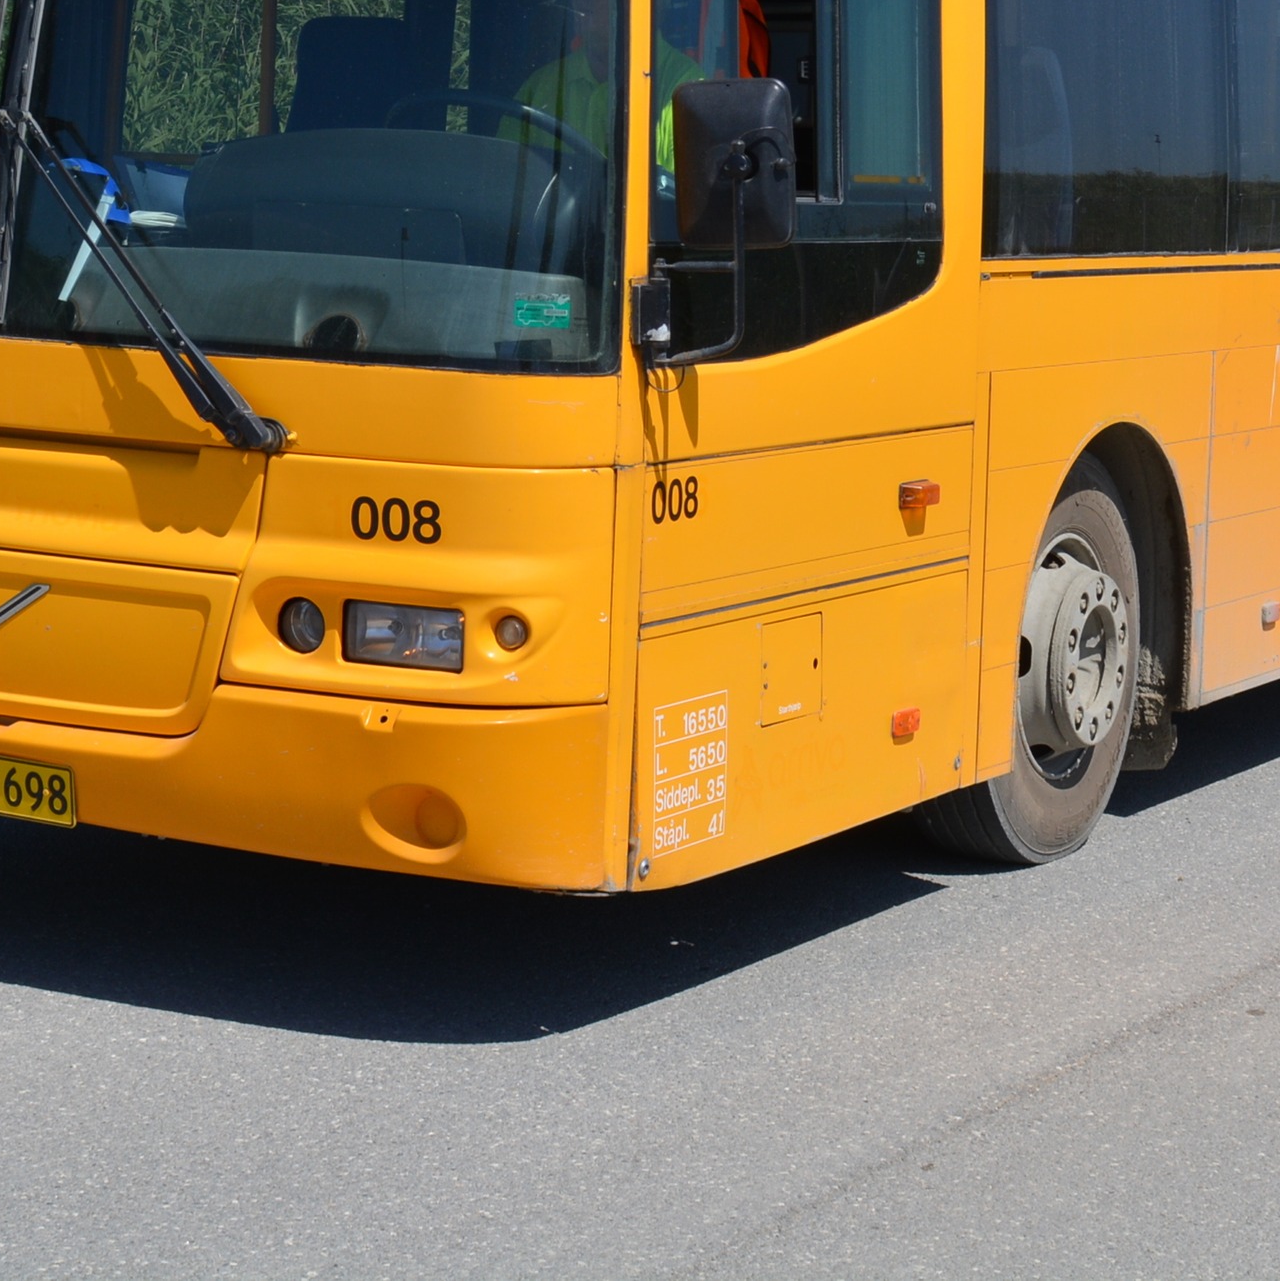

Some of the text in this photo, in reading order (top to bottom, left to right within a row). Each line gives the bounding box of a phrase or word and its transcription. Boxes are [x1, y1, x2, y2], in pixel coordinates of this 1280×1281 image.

[350, 495, 442, 545] 008
[651, 475, 699, 525] 008
[655, 704, 726, 738] T. 16550
[656, 740, 726, 776] L. 5650
[3, 767, 68, 816] 698
[655, 774, 725, 813] Siddepl. 35
[654, 809, 725, 851] Ståpl. 41
